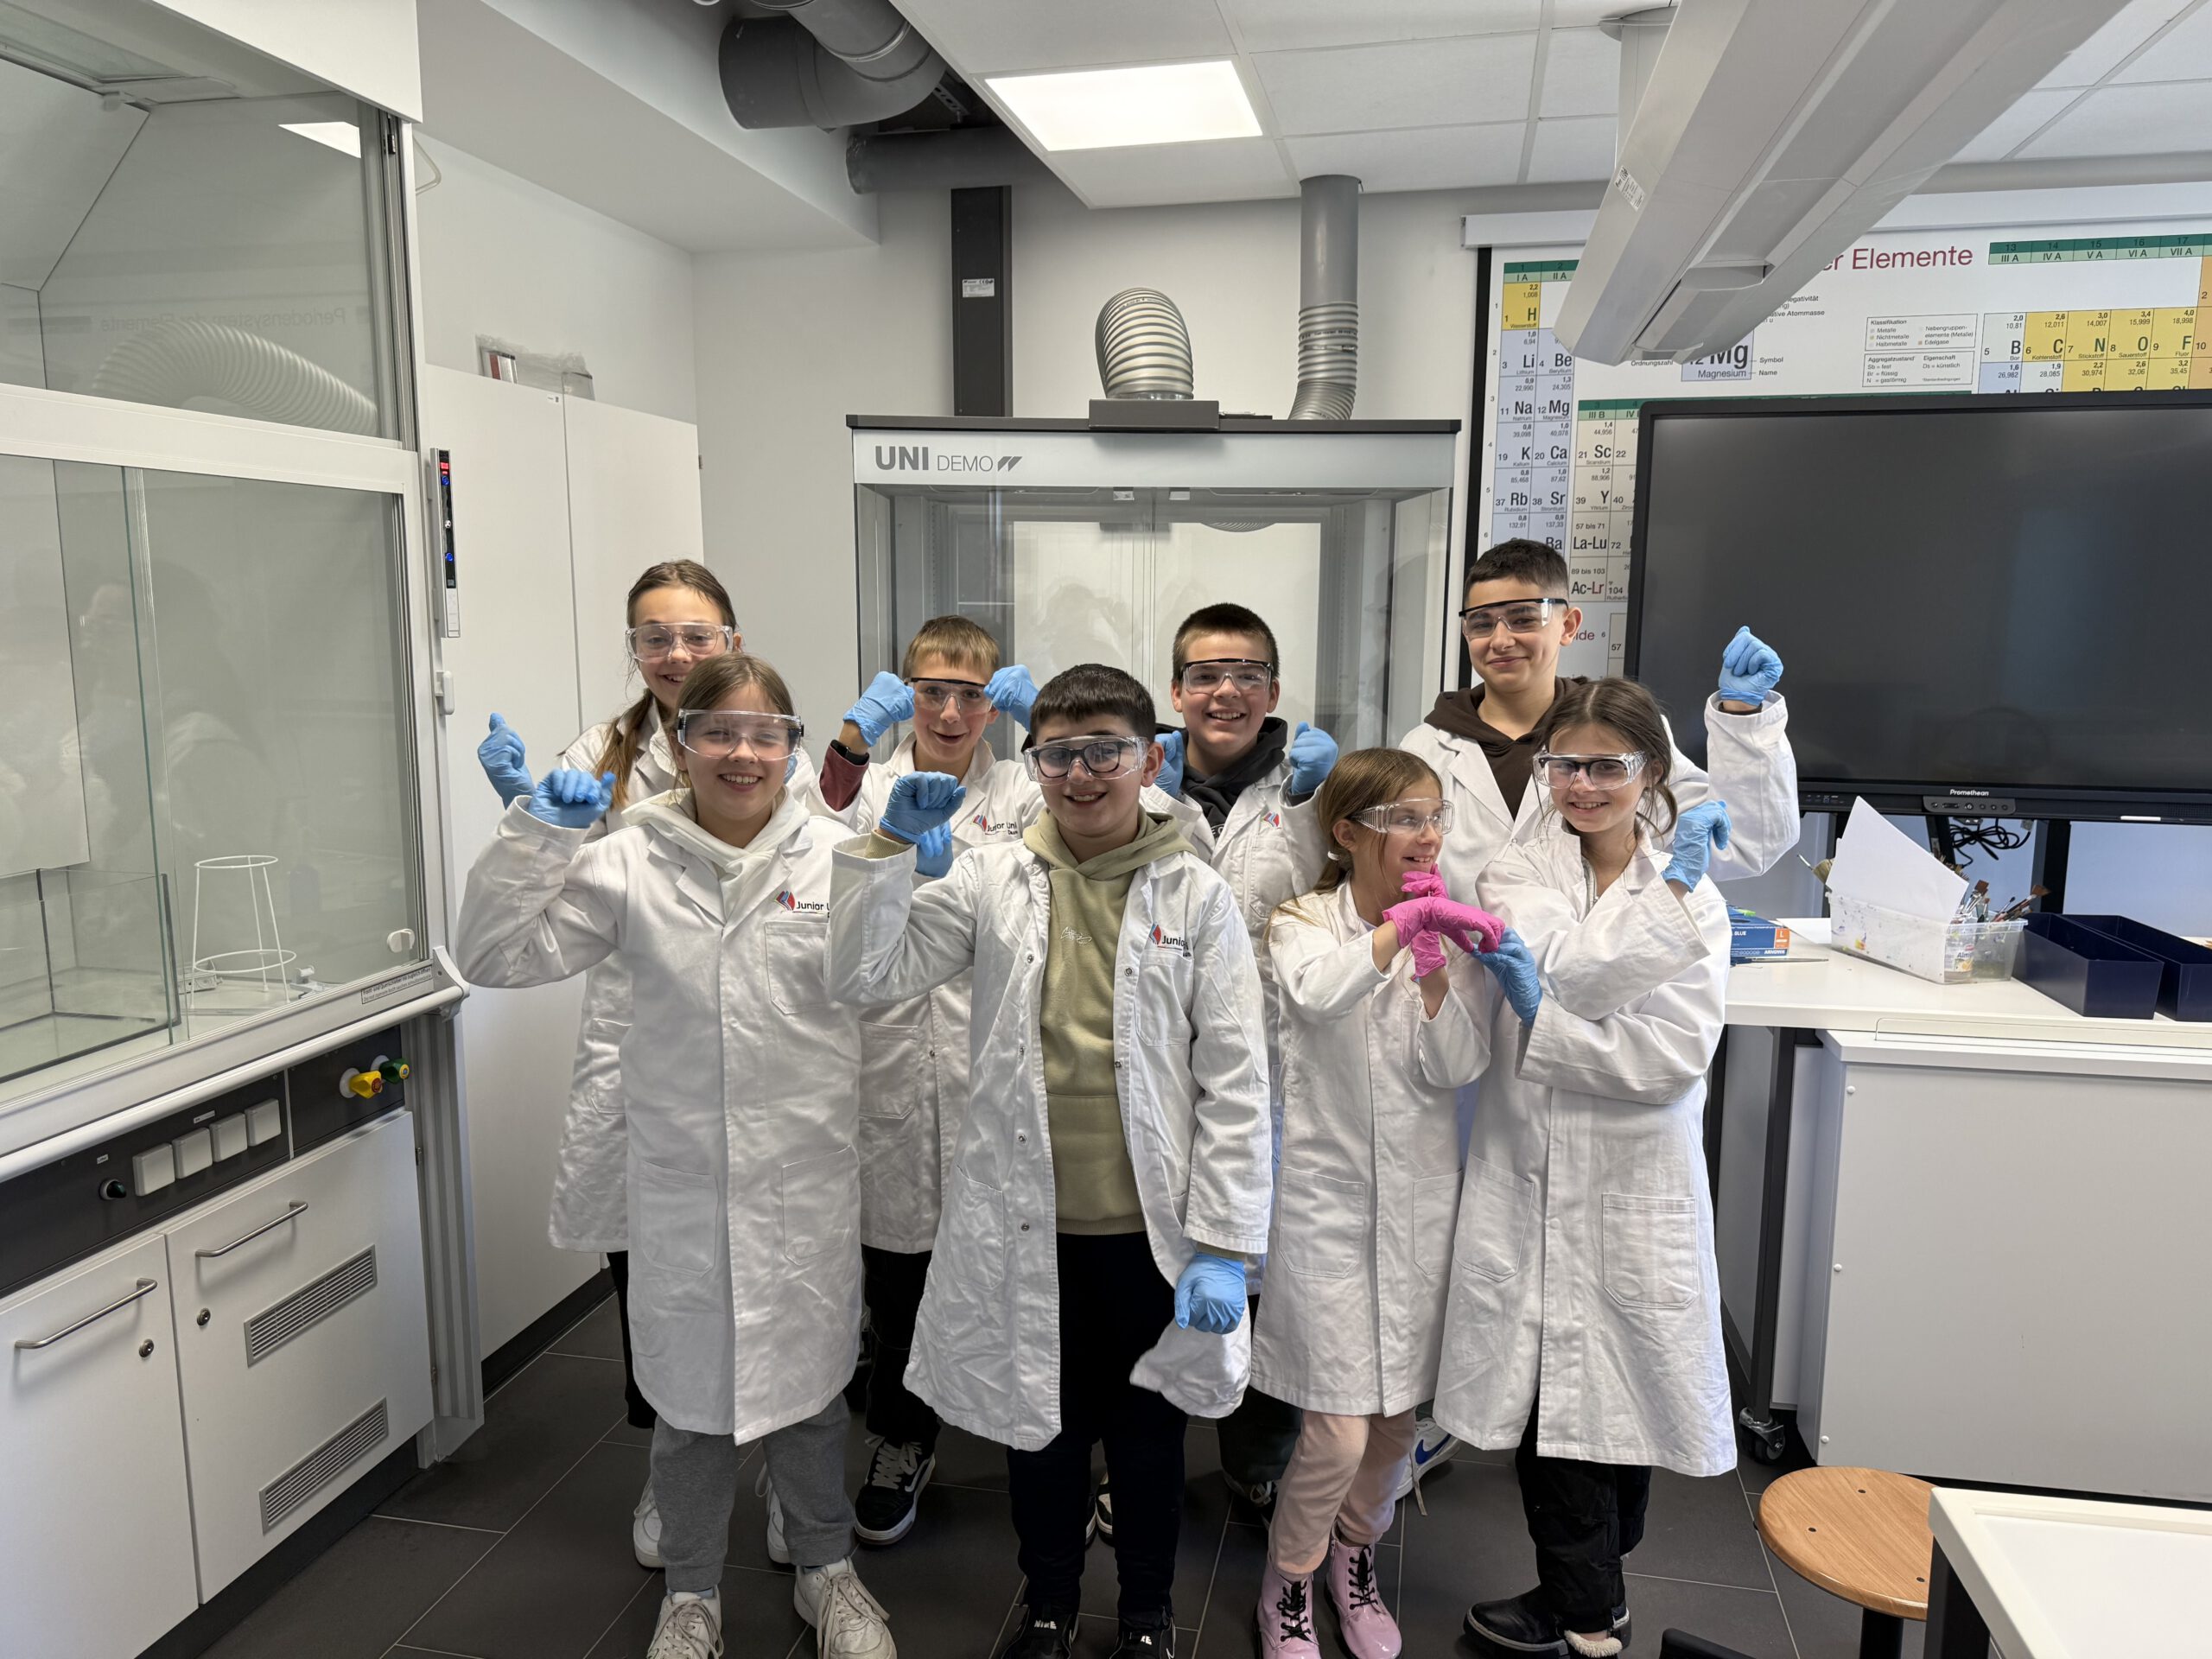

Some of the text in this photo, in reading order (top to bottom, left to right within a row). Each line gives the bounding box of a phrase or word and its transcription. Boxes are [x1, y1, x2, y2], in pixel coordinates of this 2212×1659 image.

[1852, 245, 1973, 270] Elemente
[1528, 308, 1536, 321] H
[2011, 340, 2021, 354] B
[2053, 339, 2063, 353] C
[2094, 338, 2105, 352] N
[2138, 337, 2148, 351] O
[2182, 336, 2192, 350] F
[1523, 354, 1535, 368] Li
[1555, 353, 1572, 367] Be
[1698, 370, 1746, 379] Magnesium
[1515, 401, 1532, 414] Na
[1549, 400, 1570, 416] Mg
[1522, 447, 1531, 460] K
[1551, 445, 1567, 459] Ca
[1594, 445, 1611, 458] Sc
[875, 446, 993, 472] UNI DEMO
[1511, 492, 1528, 506] Rb
[1551, 491, 1566, 505] Sr
[1601, 490, 1609, 503] Y
[1546, 537, 1562, 550] Ba
[1573, 536, 1607, 549] La-Lu
[1571, 581, 1604, 594] Ac-Lr
[797, 901, 824, 910] Junior
[1034, 1621, 1057, 1630] NIKE
